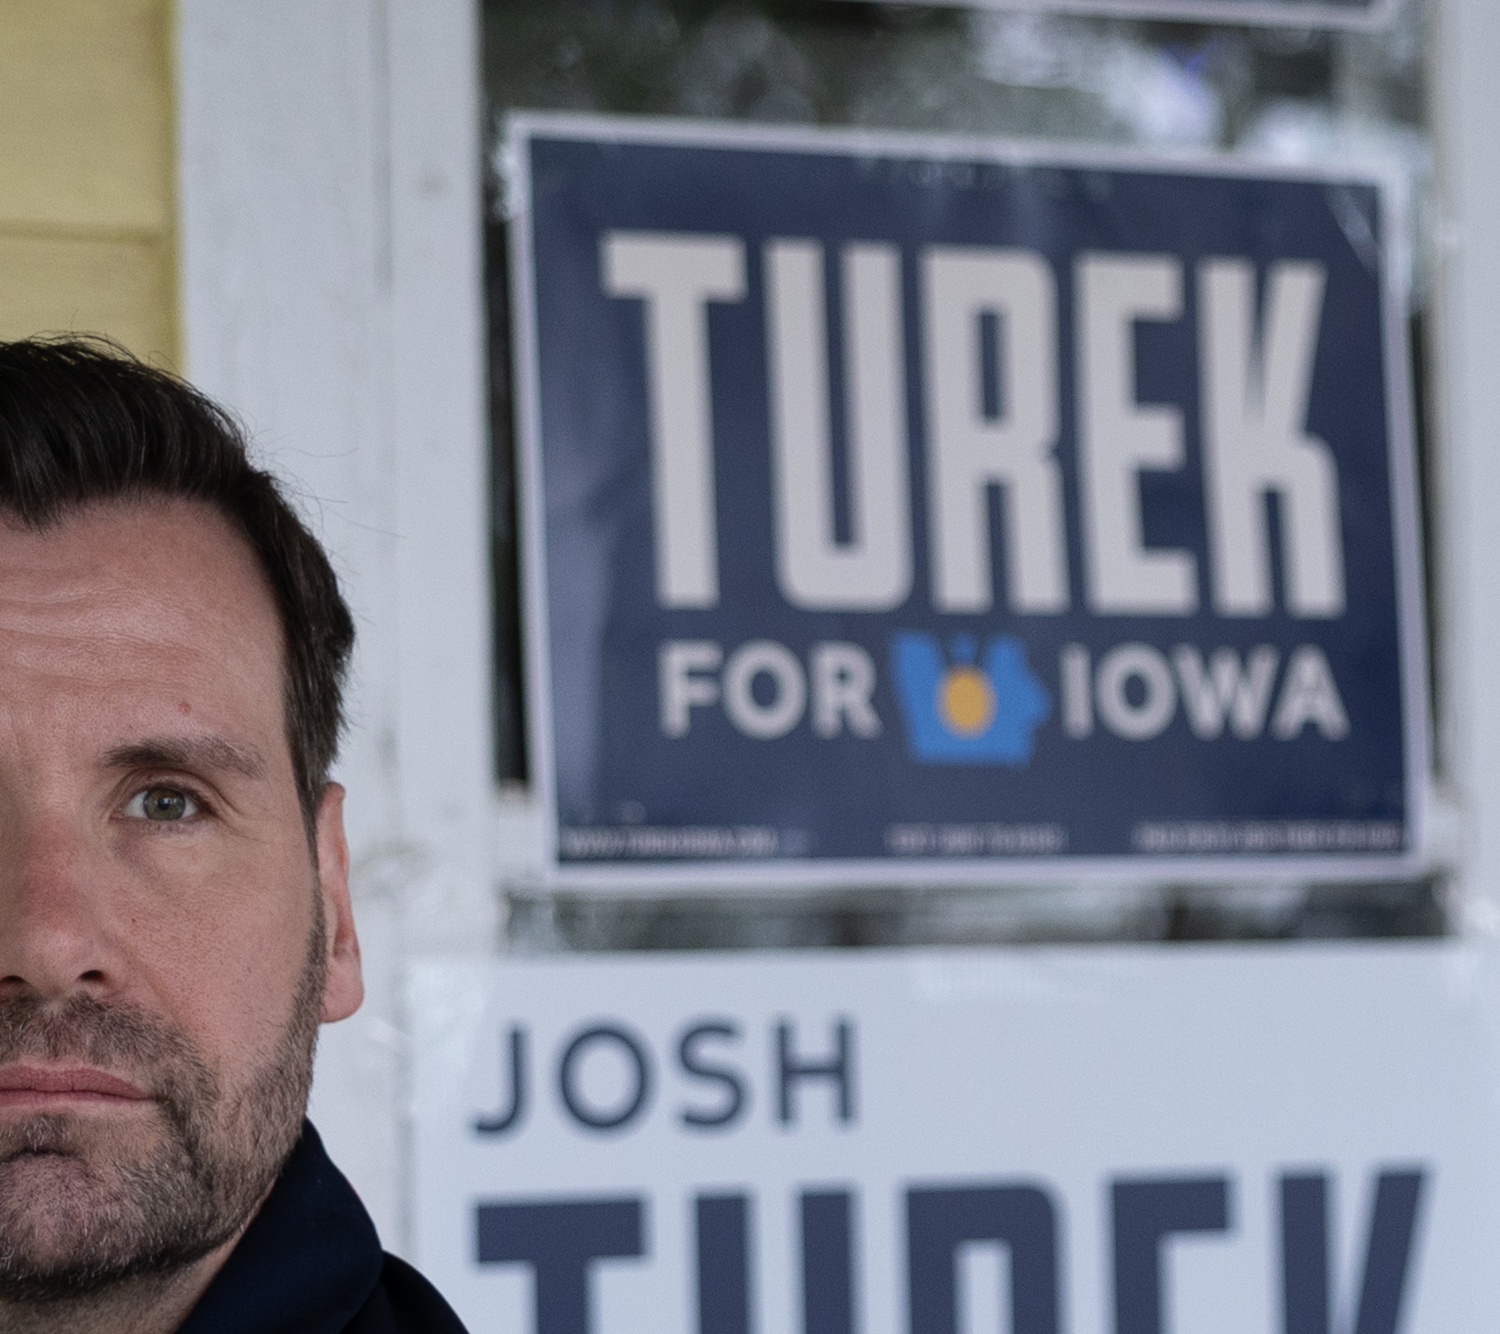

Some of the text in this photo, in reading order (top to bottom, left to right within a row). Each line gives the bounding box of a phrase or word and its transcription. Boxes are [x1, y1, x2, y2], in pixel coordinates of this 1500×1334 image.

[603, 230, 1345, 615] TUREK
[660, 640, 1348, 739] FOR IOWA
[474, 1014, 856, 1140] JOSH
